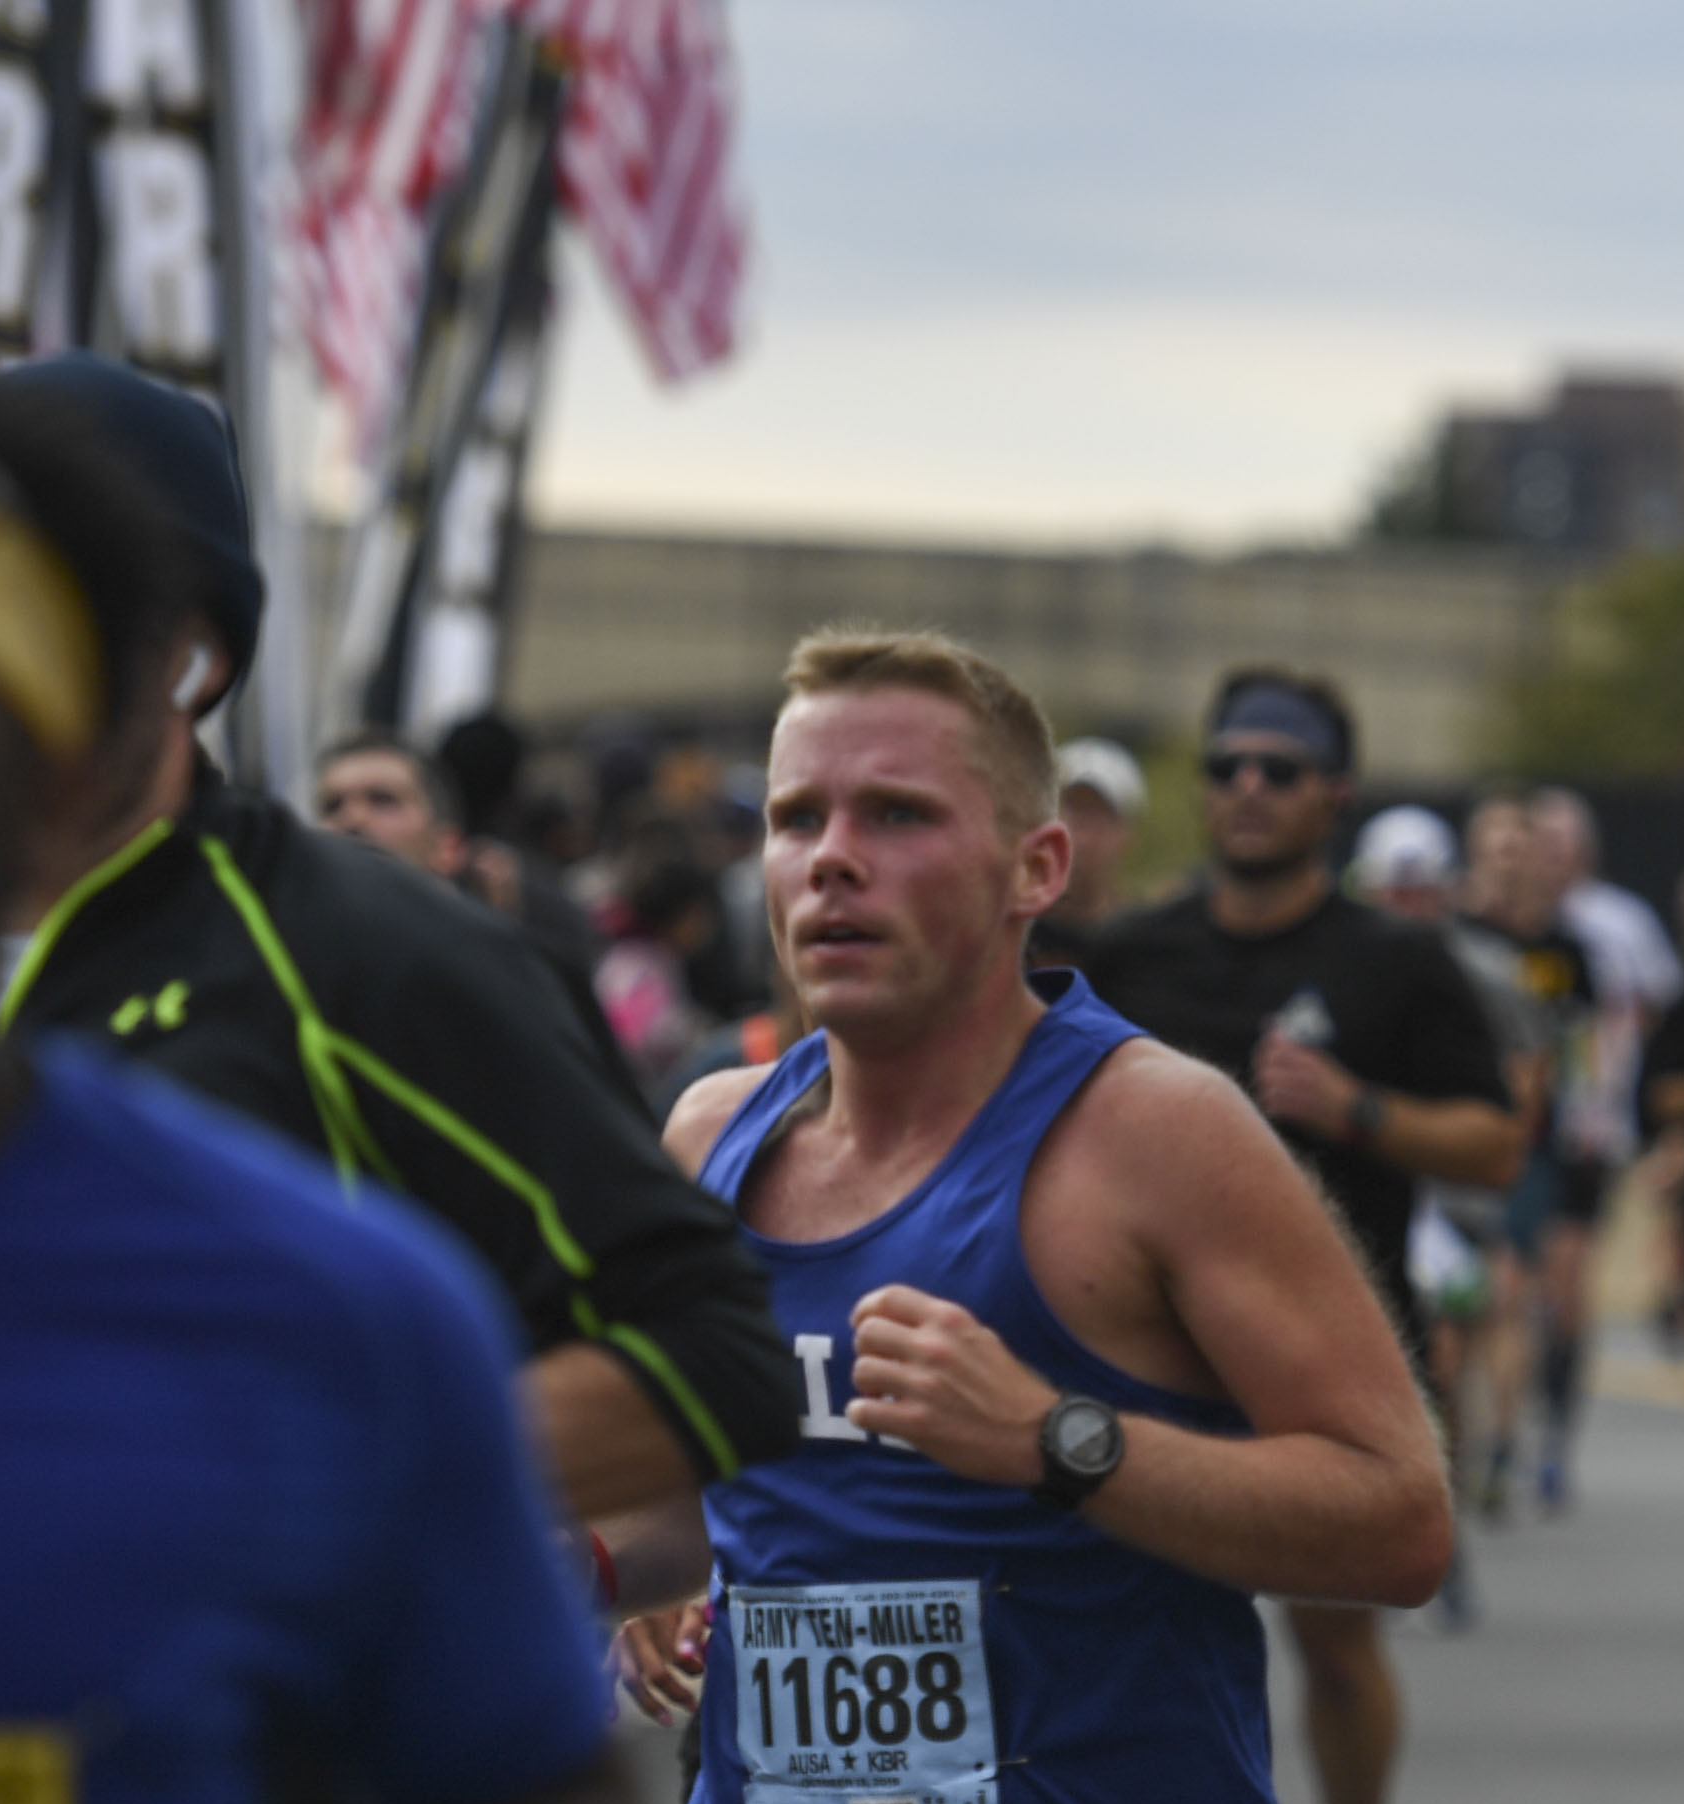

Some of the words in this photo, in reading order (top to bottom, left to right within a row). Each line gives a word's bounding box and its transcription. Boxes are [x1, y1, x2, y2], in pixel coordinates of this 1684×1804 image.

[794, 1333, 917, 1452] L
[743, 1606, 799, 1649] ARMY
[804, 1602, 964, 1650] TEN-MILER
[751, 1651, 967, 1748] 11688
[788, 1753, 831, 1775] AUSA
[867, 1750, 910, 1774] KBR
